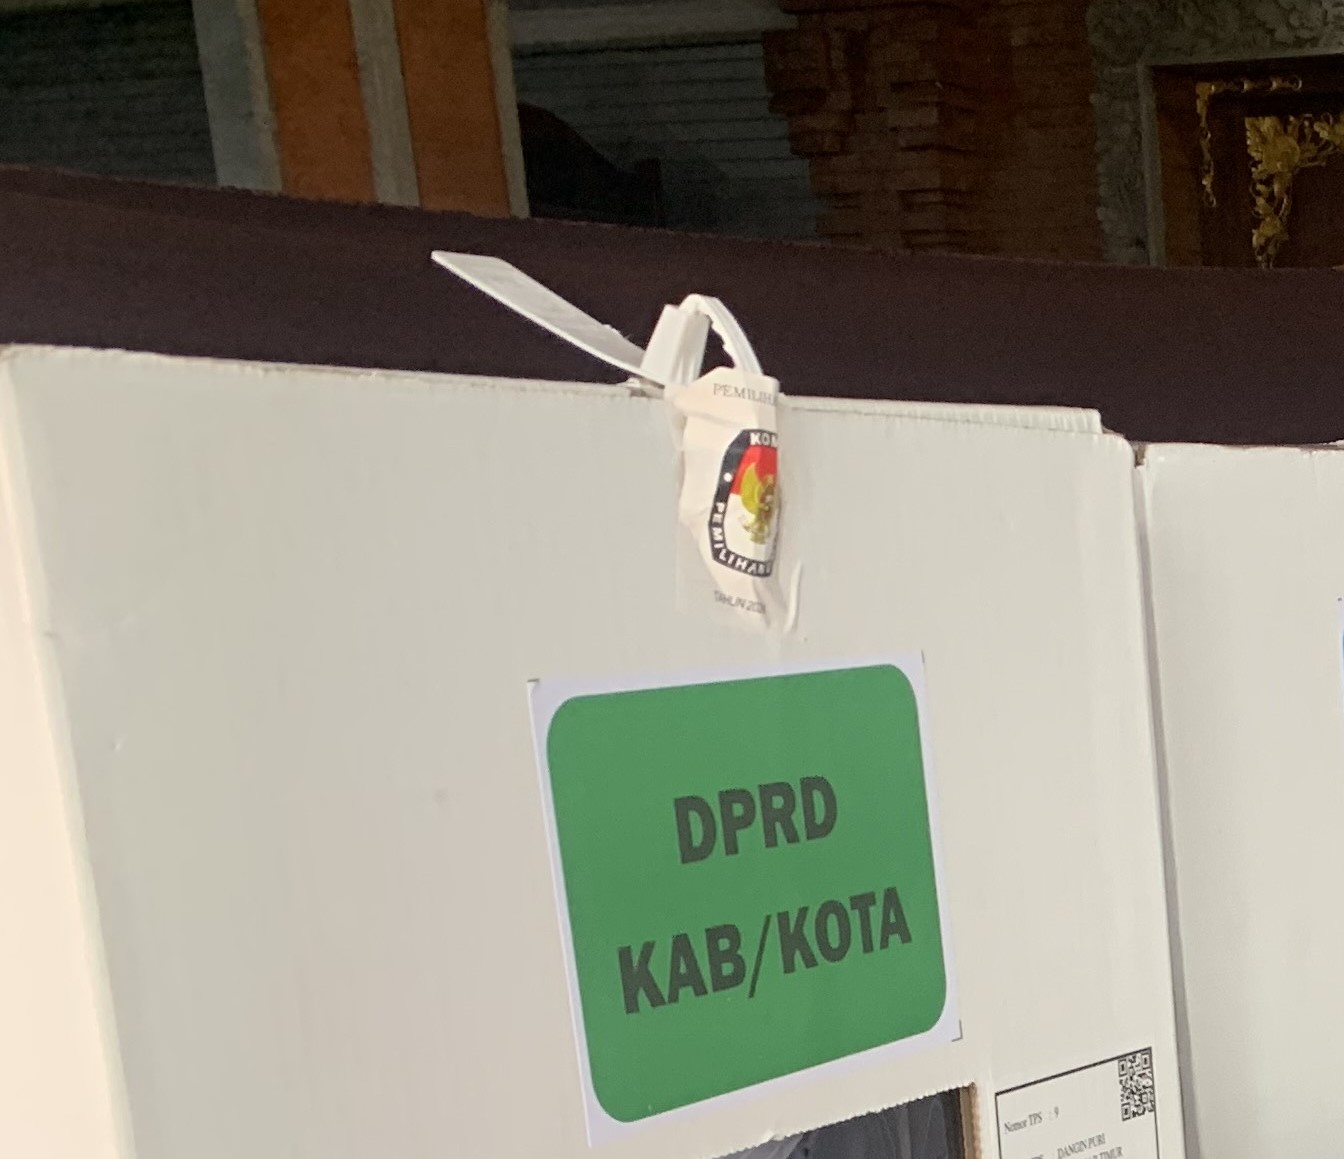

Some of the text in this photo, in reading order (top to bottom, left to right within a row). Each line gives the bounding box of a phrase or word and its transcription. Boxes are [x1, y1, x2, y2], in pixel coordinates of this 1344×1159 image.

[674, 775, 838, 864] DPRD
[619, 887, 912, 1014] KAB/KOTA
[1004, 1119, 1027, 1134] Nomor
[1028, 1111, 1042, 1126] TPS
[1057, 1140, 1087, 1159] DANGIN
[1088, 1133, 1105, 1149] PURI
